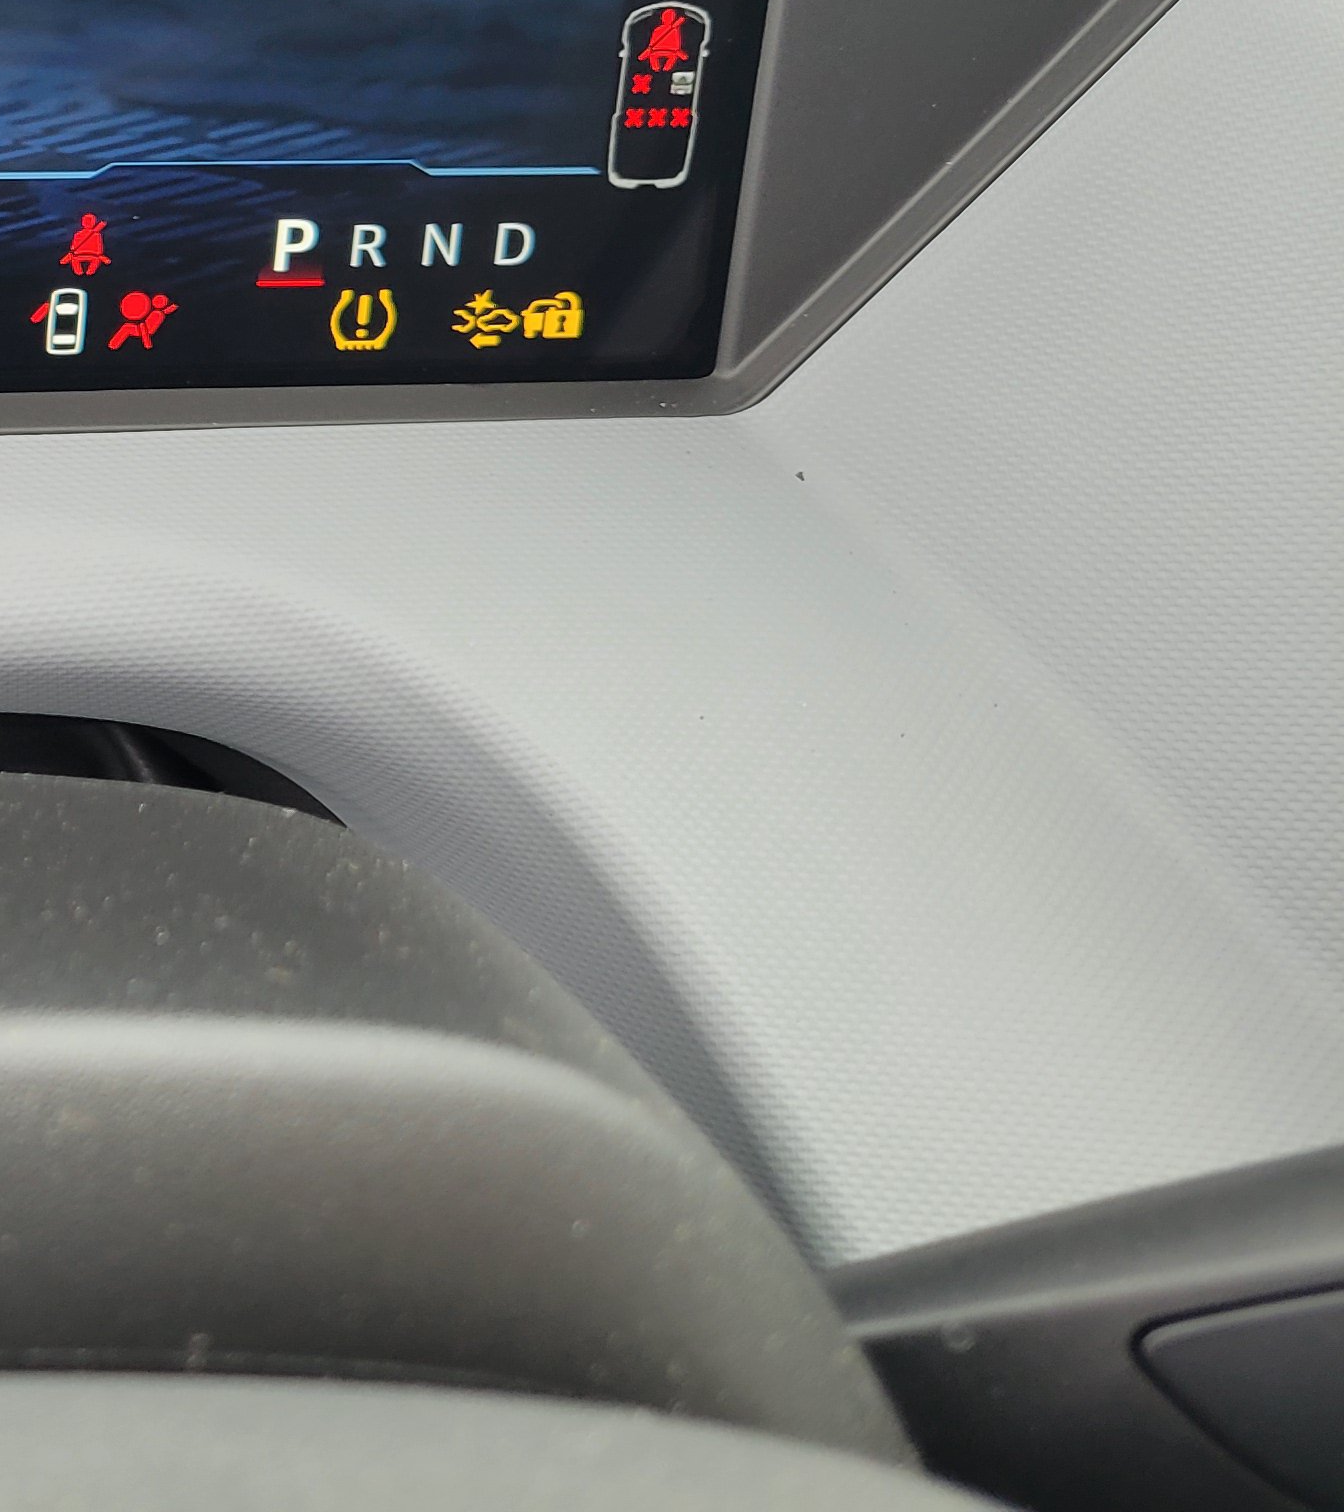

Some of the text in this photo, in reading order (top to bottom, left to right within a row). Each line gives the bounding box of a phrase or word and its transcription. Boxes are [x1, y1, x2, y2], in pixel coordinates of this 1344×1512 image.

[273, 218, 535, 272] P R N D
